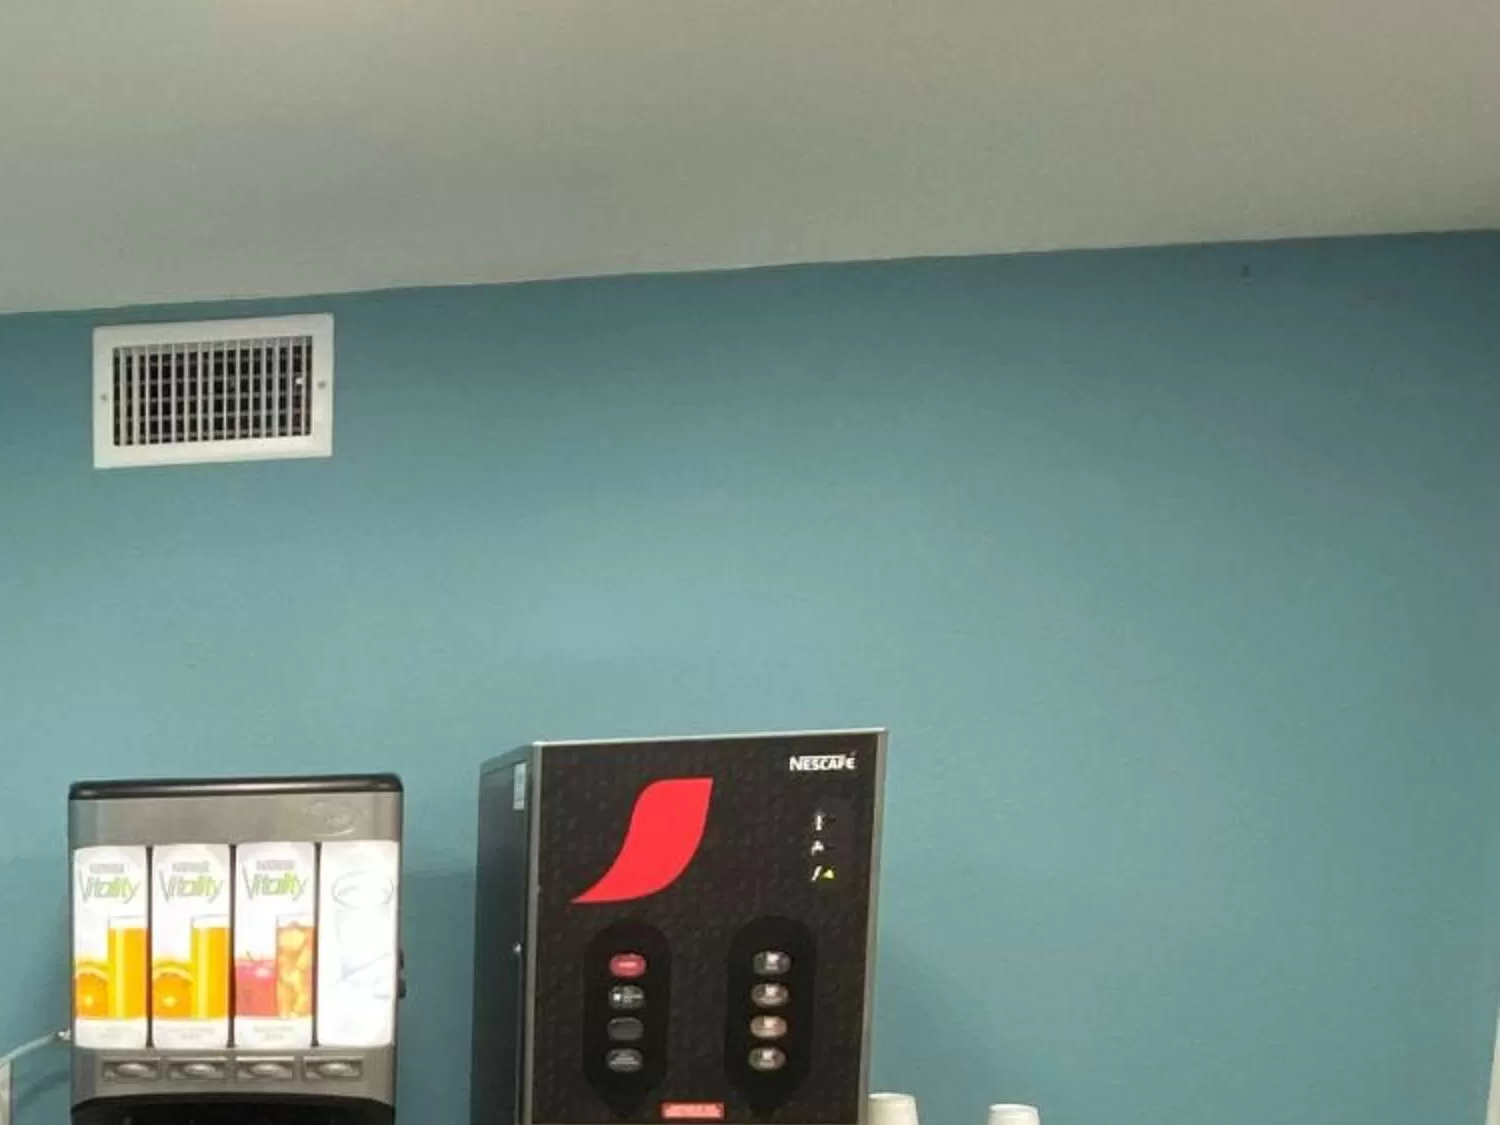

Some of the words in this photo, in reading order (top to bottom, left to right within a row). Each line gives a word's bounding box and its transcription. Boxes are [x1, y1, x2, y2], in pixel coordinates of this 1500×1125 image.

[79, 868, 142, 904] Vitality
[158, 868, 224, 903] Vitality
[242, 863, 309, 902] Vitality
